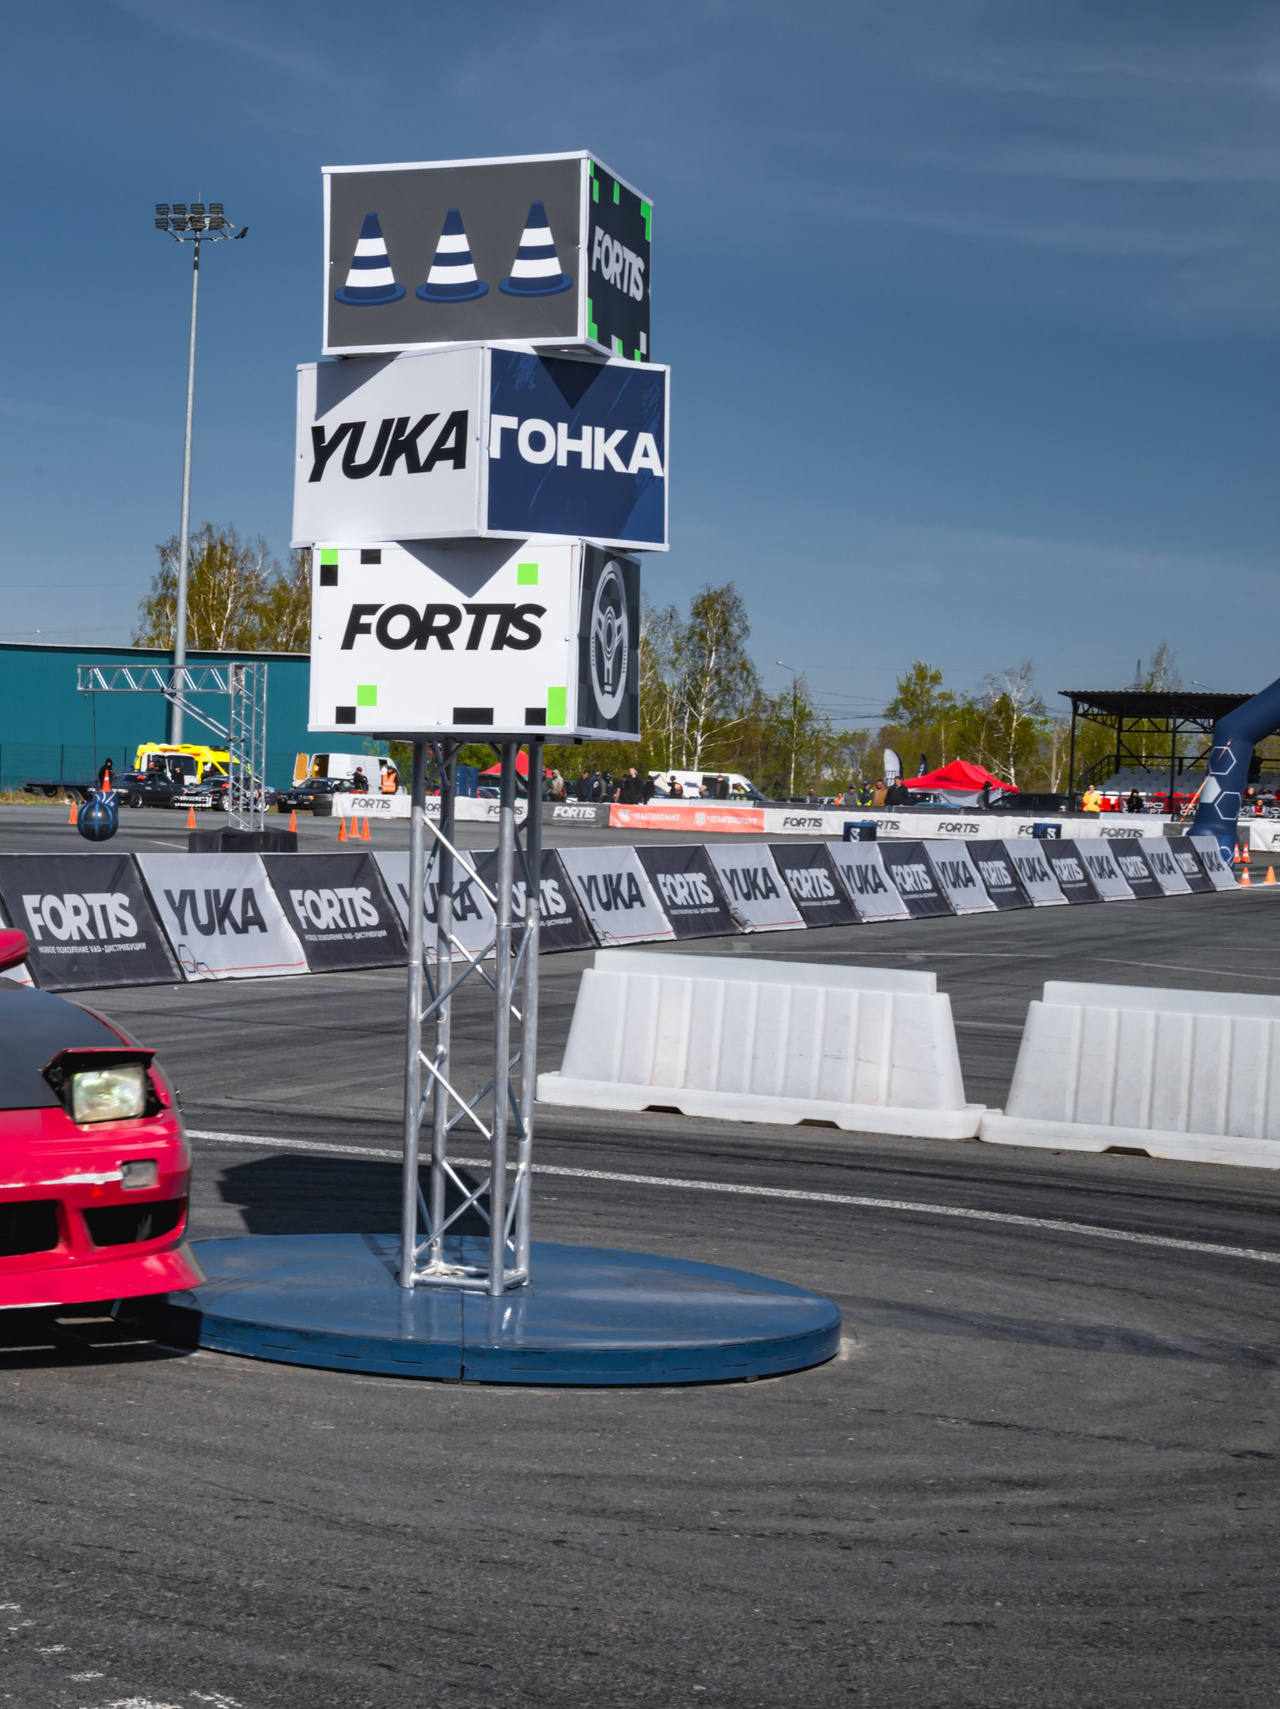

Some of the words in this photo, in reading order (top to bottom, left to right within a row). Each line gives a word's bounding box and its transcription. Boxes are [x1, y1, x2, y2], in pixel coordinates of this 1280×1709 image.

[591, 225, 645, 302] FORTIS
[308, 410, 469, 483] YUKA
[489, 414, 665, 477] ГОНКА
[340, 603, 547, 651] FORTIS
[351, 797, 392, 809] FORTIS
[487, 805, 524, 815] FOIS
[552, 805, 597, 818] FORTIS
[630, 812, 680, 822] ЧЕМПИОНАТ
[783, 817, 823, 828] FORTIS
[861, 819, 901, 831] RTIS
[937, 822, 981, 834] FORTIS
[1099, 827, 1144, 838] FORTIS
[840, 864, 888, 895] YUKA
[891, 864, 933, 892] FORTIS
[936, 861, 976, 889] YUKA
[978, 860, 1012, 886] FORTIS
[1014, 857, 1051, 883] YUKA
[1052, 858, 1084, 881] FORTIS
[1085, 856, 1118, 879] YUKA
[577, 872, 646, 912] YUKA
[656, 872, 714, 906] FORTIS
[721, 867, 781, 901] YUKA
[785, 868, 835, 898] FORTIS
[163, 887, 268, 936] YUKA
[289, 887, 379, 930] FORTIS
[495, 879, 567, 918] OTIS
[22, 893, 138, 940] FORTIS
